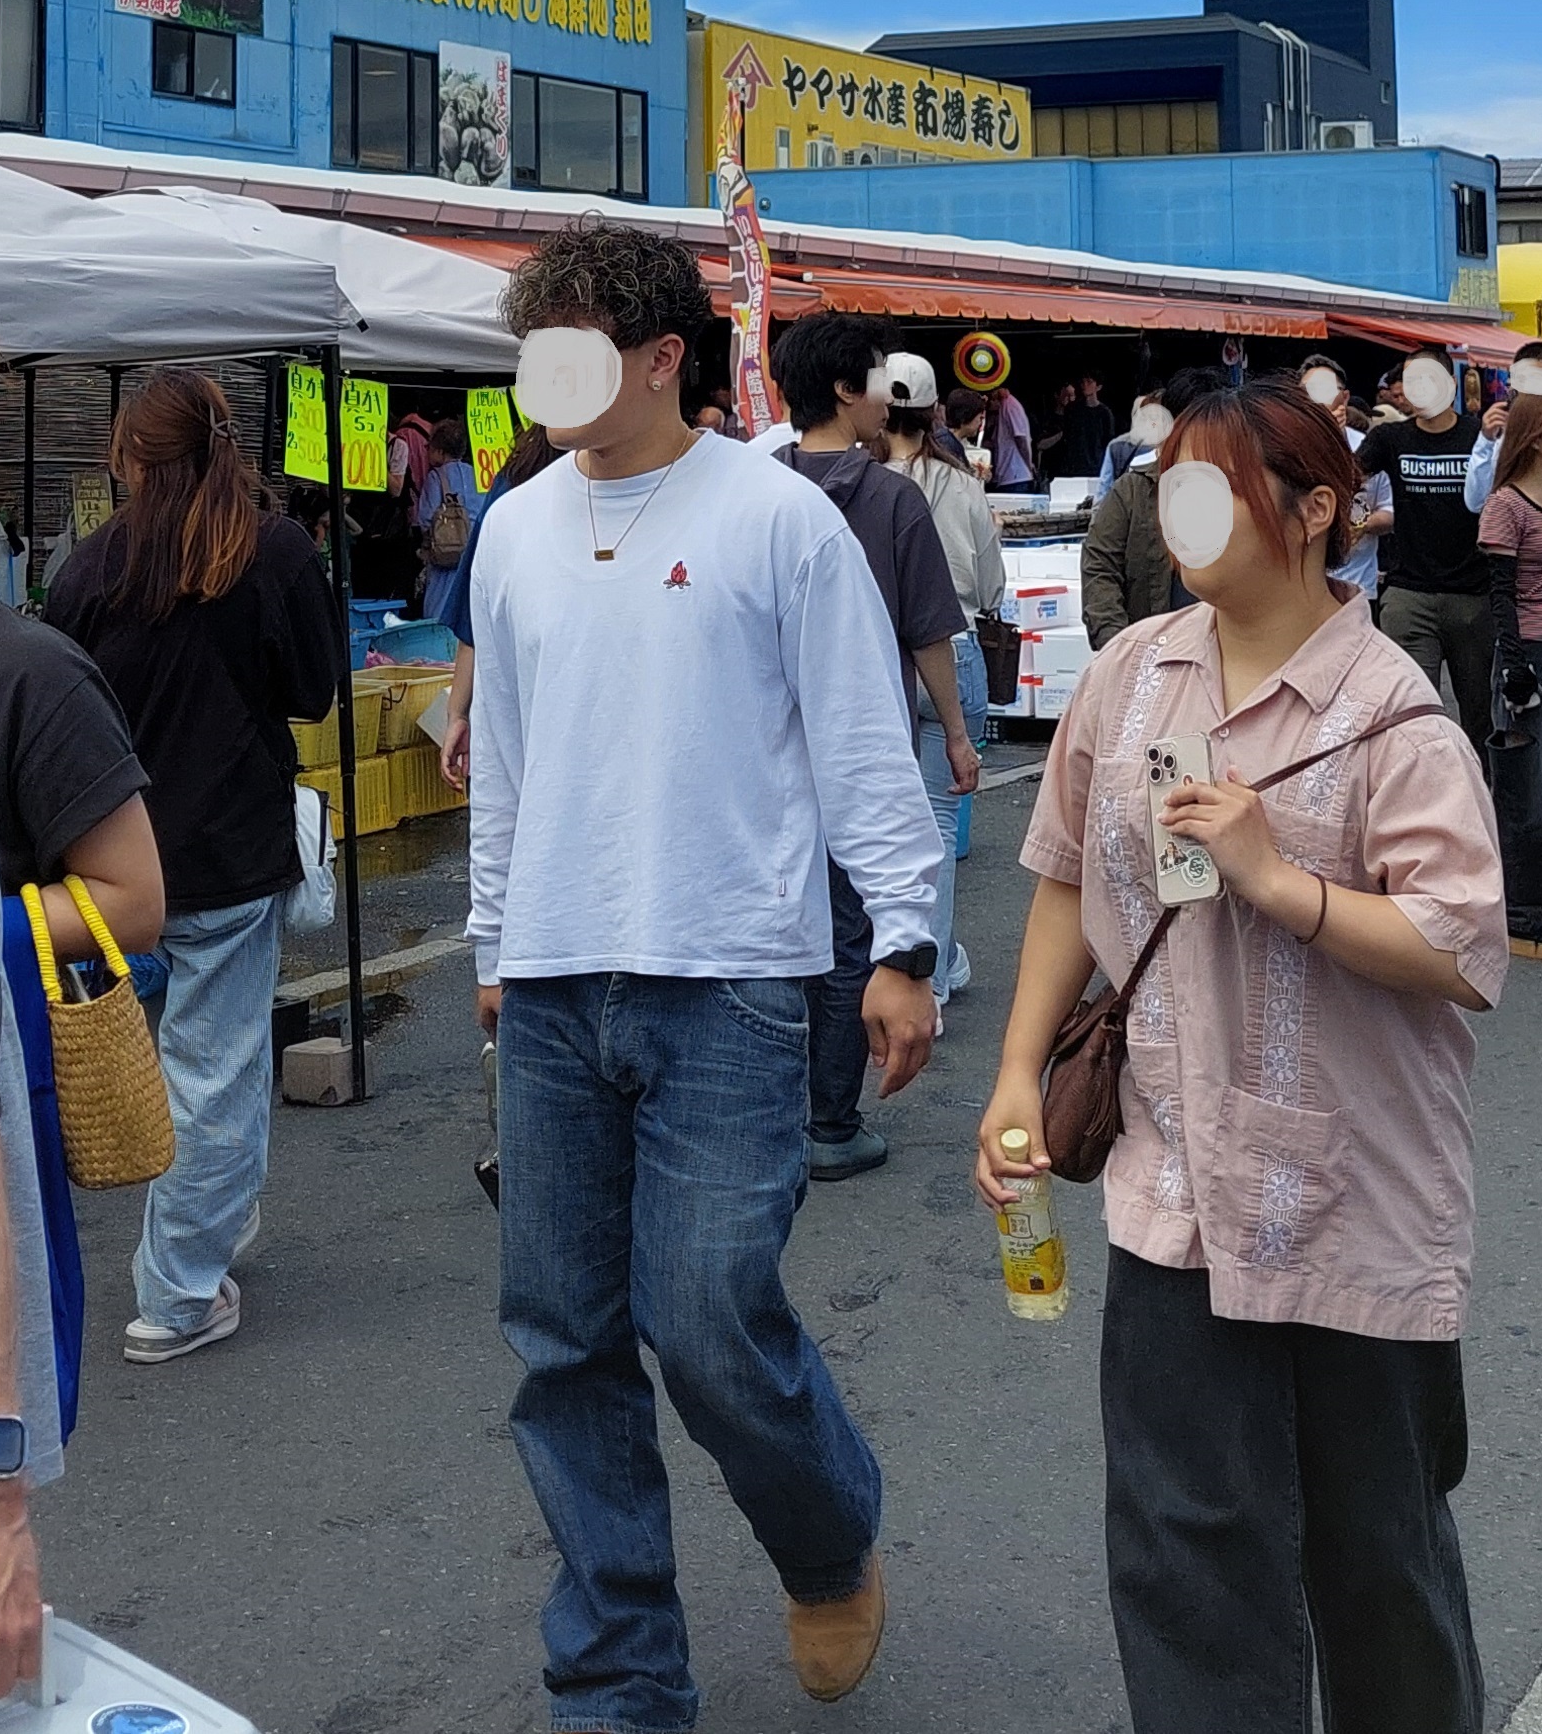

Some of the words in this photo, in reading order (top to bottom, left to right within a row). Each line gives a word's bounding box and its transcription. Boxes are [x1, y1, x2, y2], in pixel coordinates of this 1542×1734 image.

[782, 56, 907, 130] ヤマサ水産
[914, 79, 1021, 152] 市場寿し
